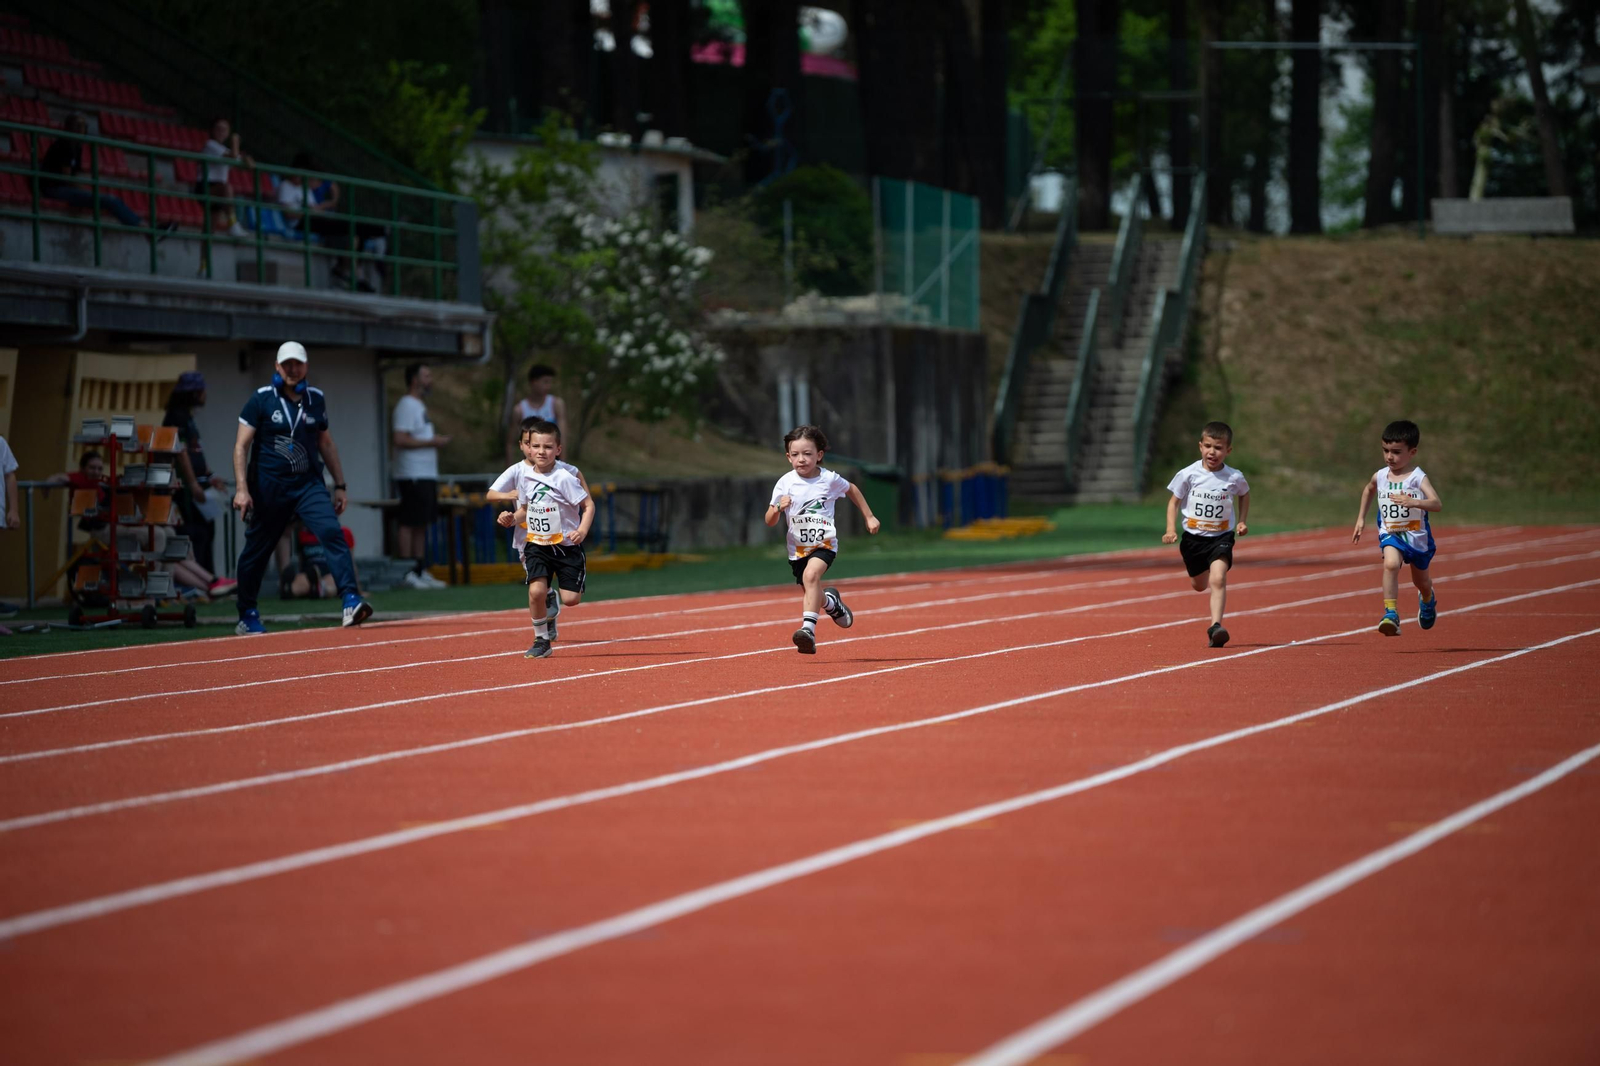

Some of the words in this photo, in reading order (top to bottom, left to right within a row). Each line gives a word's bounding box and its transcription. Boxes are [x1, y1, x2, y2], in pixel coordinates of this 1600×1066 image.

[1194, 502, 1224, 519] 582
[1381, 504, 1410, 519] 383
[529, 517, 550, 532] 535
[800, 528, 825, 543] 533
